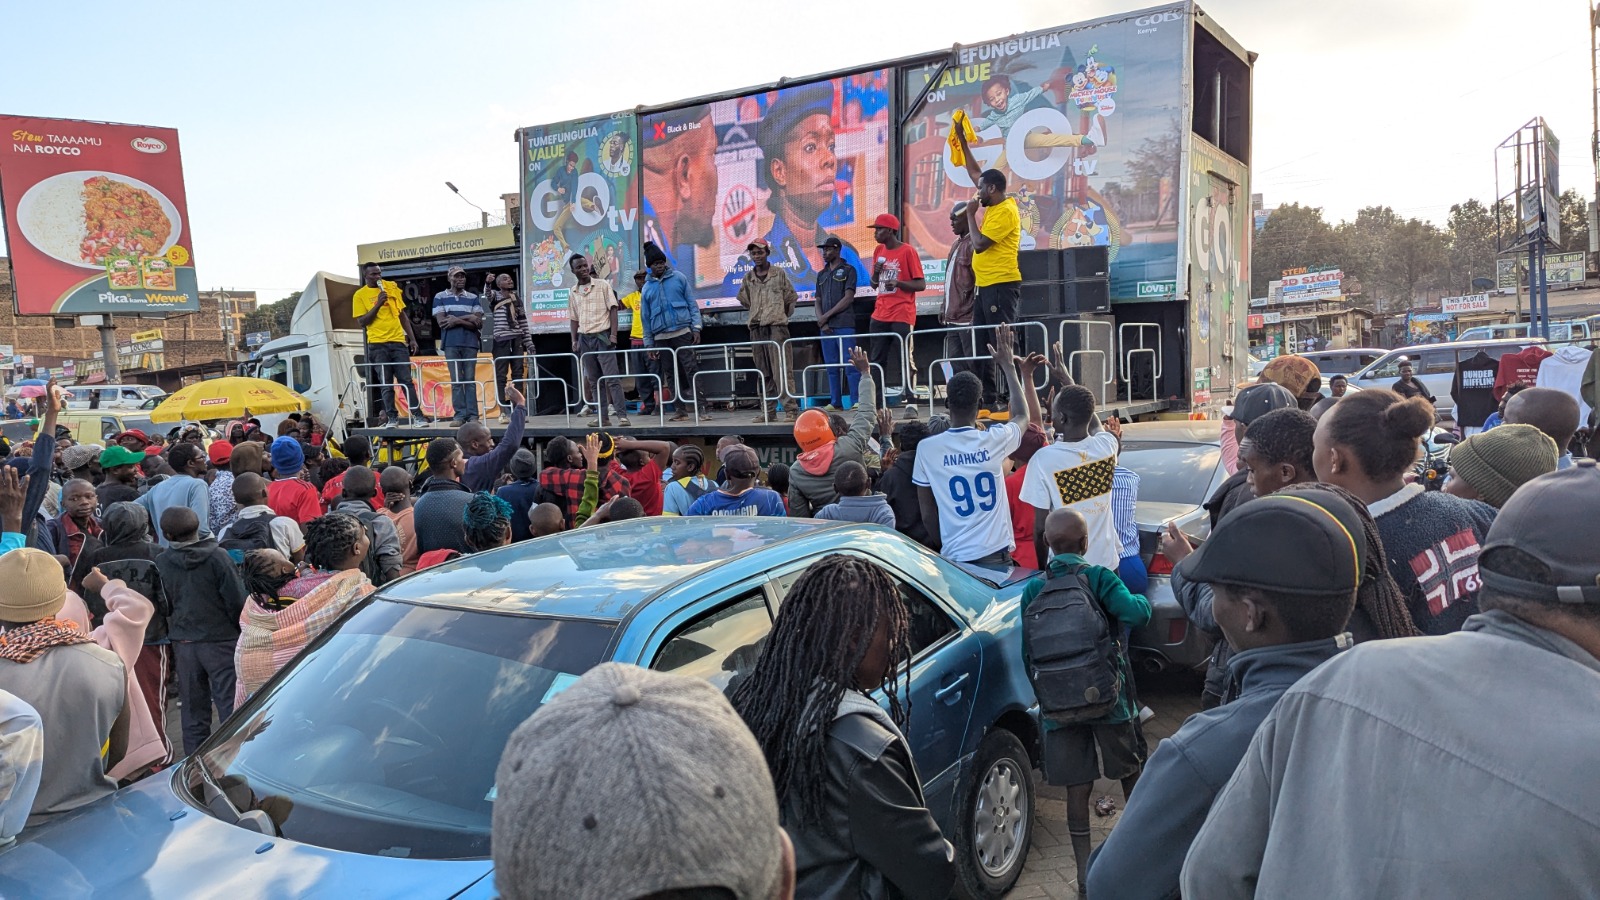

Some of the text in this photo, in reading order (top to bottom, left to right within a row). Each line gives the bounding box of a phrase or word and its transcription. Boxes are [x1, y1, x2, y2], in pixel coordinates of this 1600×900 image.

[927, 90, 946, 103] ON
[1069, 90, 1093, 99] MICKEY
[667, 124, 682, 133] Black
[688, 122, 702, 130] Blue
[12, 130, 102, 146] Stew TAAAAMU
[528, 126, 598, 148] TUMEFUNGULIA
[14, 144, 80, 156] NA ROYCO
[137, 142, 161, 150] Royco
[528, 144, 565, 162] VALUE
[528, 162, 540, 172] ON
[378, 238, 484, 260] Visit www.gotvafrica.com
[1564, 254, 1583, 262] SHOP
[1282, 266, 1306, 276] STEM
[98, 292, 129, 304] Pika
[145, 293, 188, 303] Wewe
[1463, 370, 1494, 378] DUNDER
[948, 472, 997, 517] 99
